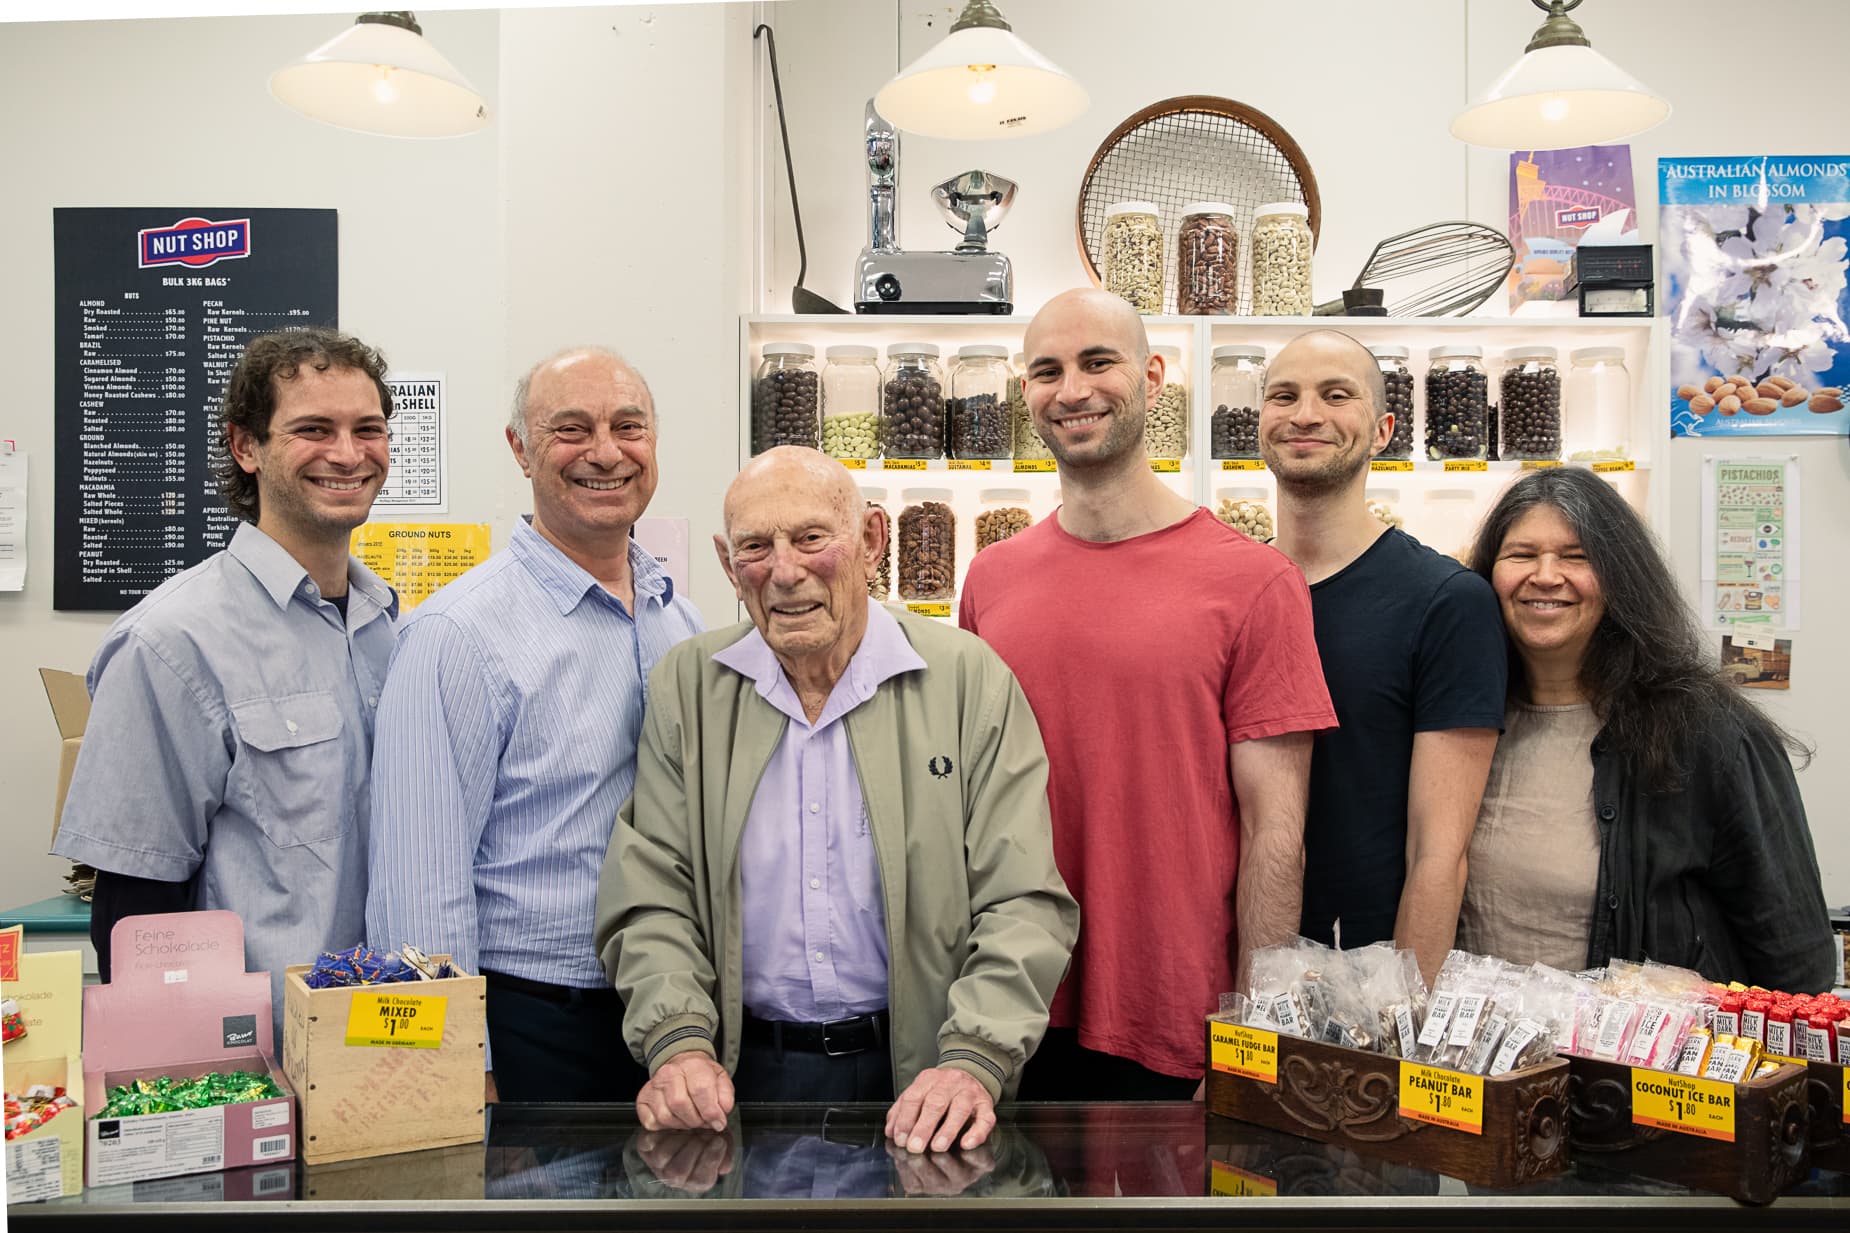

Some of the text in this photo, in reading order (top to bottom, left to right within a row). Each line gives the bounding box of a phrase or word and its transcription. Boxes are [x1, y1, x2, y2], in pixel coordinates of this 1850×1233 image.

[1666, 163, 1847, 178] AUSTRALIAN ALMONDS
[1709, 184, 1727, 198] IN
[152, 230, 238, 254] NUT SHOP
[162, 278, 184, 286] BULK
[186, 278, 202, 286] 3KG
[390, 385, 436, 396] RALIAN
[1721, 469, 1779, 481] PISTACHIOS
[136, 939, 220, 956] Schokolade
[392, 997, 422, 1006] Chocolate
[380, 1006, 416, 1018] MIXED
[1213, 1034, 1275, 1054] CARAMEL FUDGE BAR
[1421, 1069, 1460, 1084] Milk Chocolate
[1409, 1075, 1472, 1099] PEANUT BAR
[1668, 1078, 1696, 1091] NutShop
[1636, 1082, 1730, 1107] COCONUT ICE BAR
[1669, 1100, 1696, 1120] $1.80
